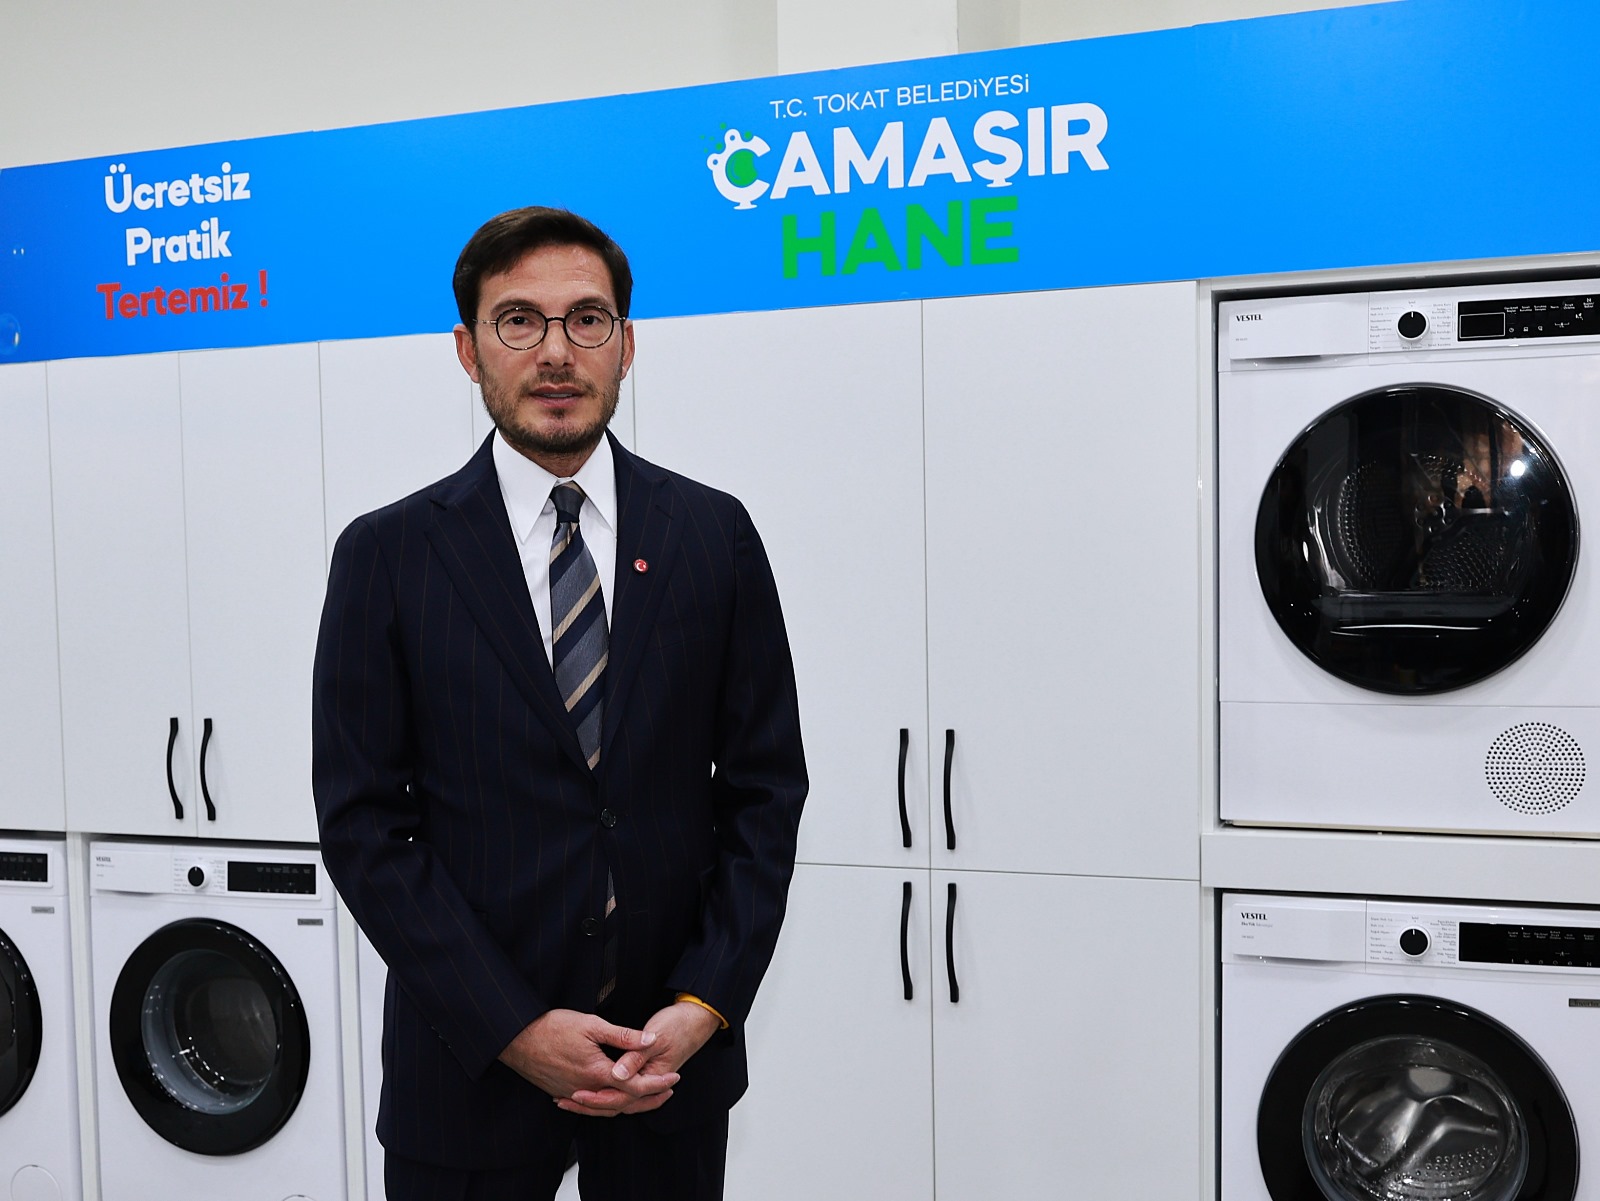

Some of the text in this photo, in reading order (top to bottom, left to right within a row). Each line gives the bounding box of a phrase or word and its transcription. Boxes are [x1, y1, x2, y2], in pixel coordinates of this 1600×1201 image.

[770, 98, 807, 118] T.C.
[813, 88, 890, 113] TOKAT
[706, 102, 1110, 210] ÇAMAŞIR
[104, 161, 251, 213] Ücretsiz
[125, 217, 232, 266] Pratik
[782, 196, 1019, 279] HANE
[96, 272, 249, 320] Tertemiz
[1235, 313, 1263, 322] VESTEL
[1240, 912, 1268, 921] VESTEL
